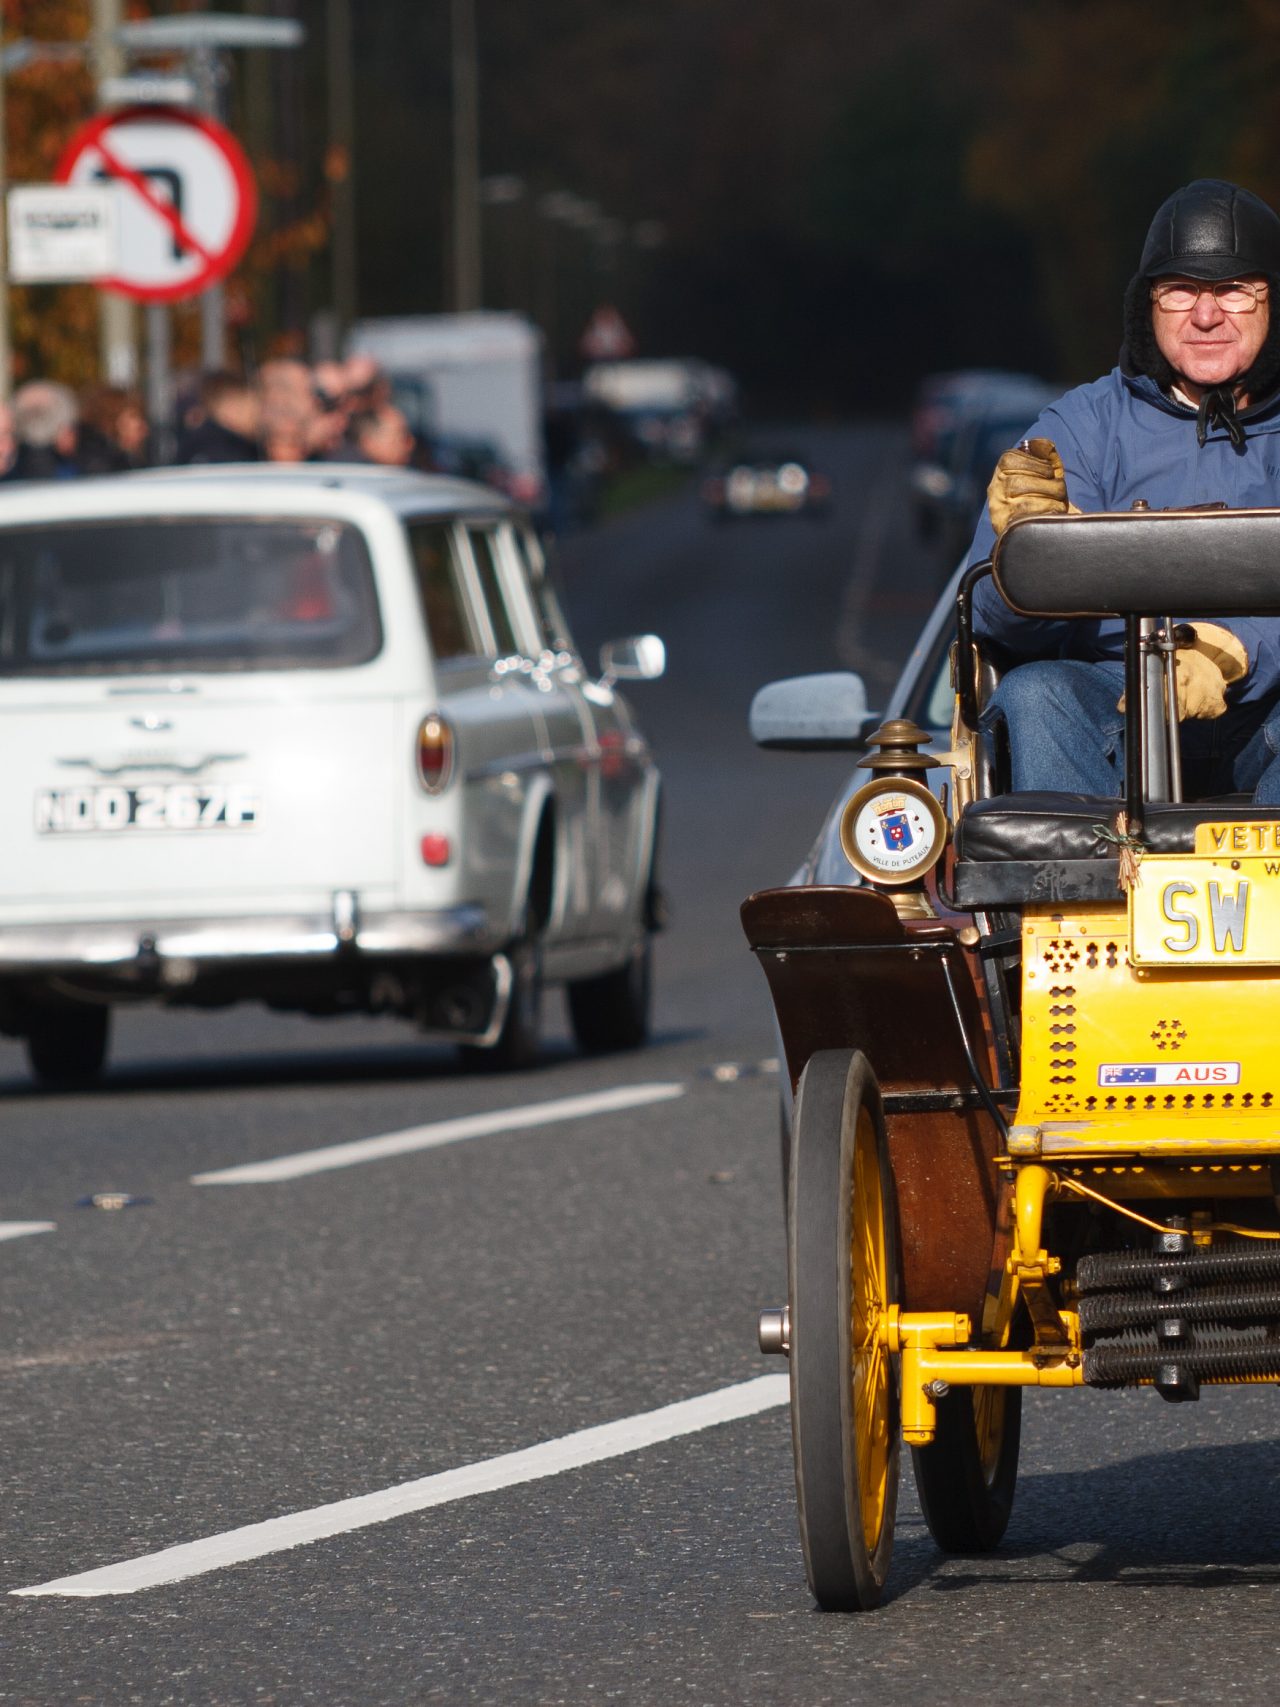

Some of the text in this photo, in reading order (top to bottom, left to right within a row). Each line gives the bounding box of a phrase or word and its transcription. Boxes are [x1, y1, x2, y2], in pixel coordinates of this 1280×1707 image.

[873, 855, 889, 867] VILLE
[903, 845, 931, 865] PUTEAUX
[1162, 881, 1249, 952] SW
[1175, 1067, 1228, 1081] AUS
